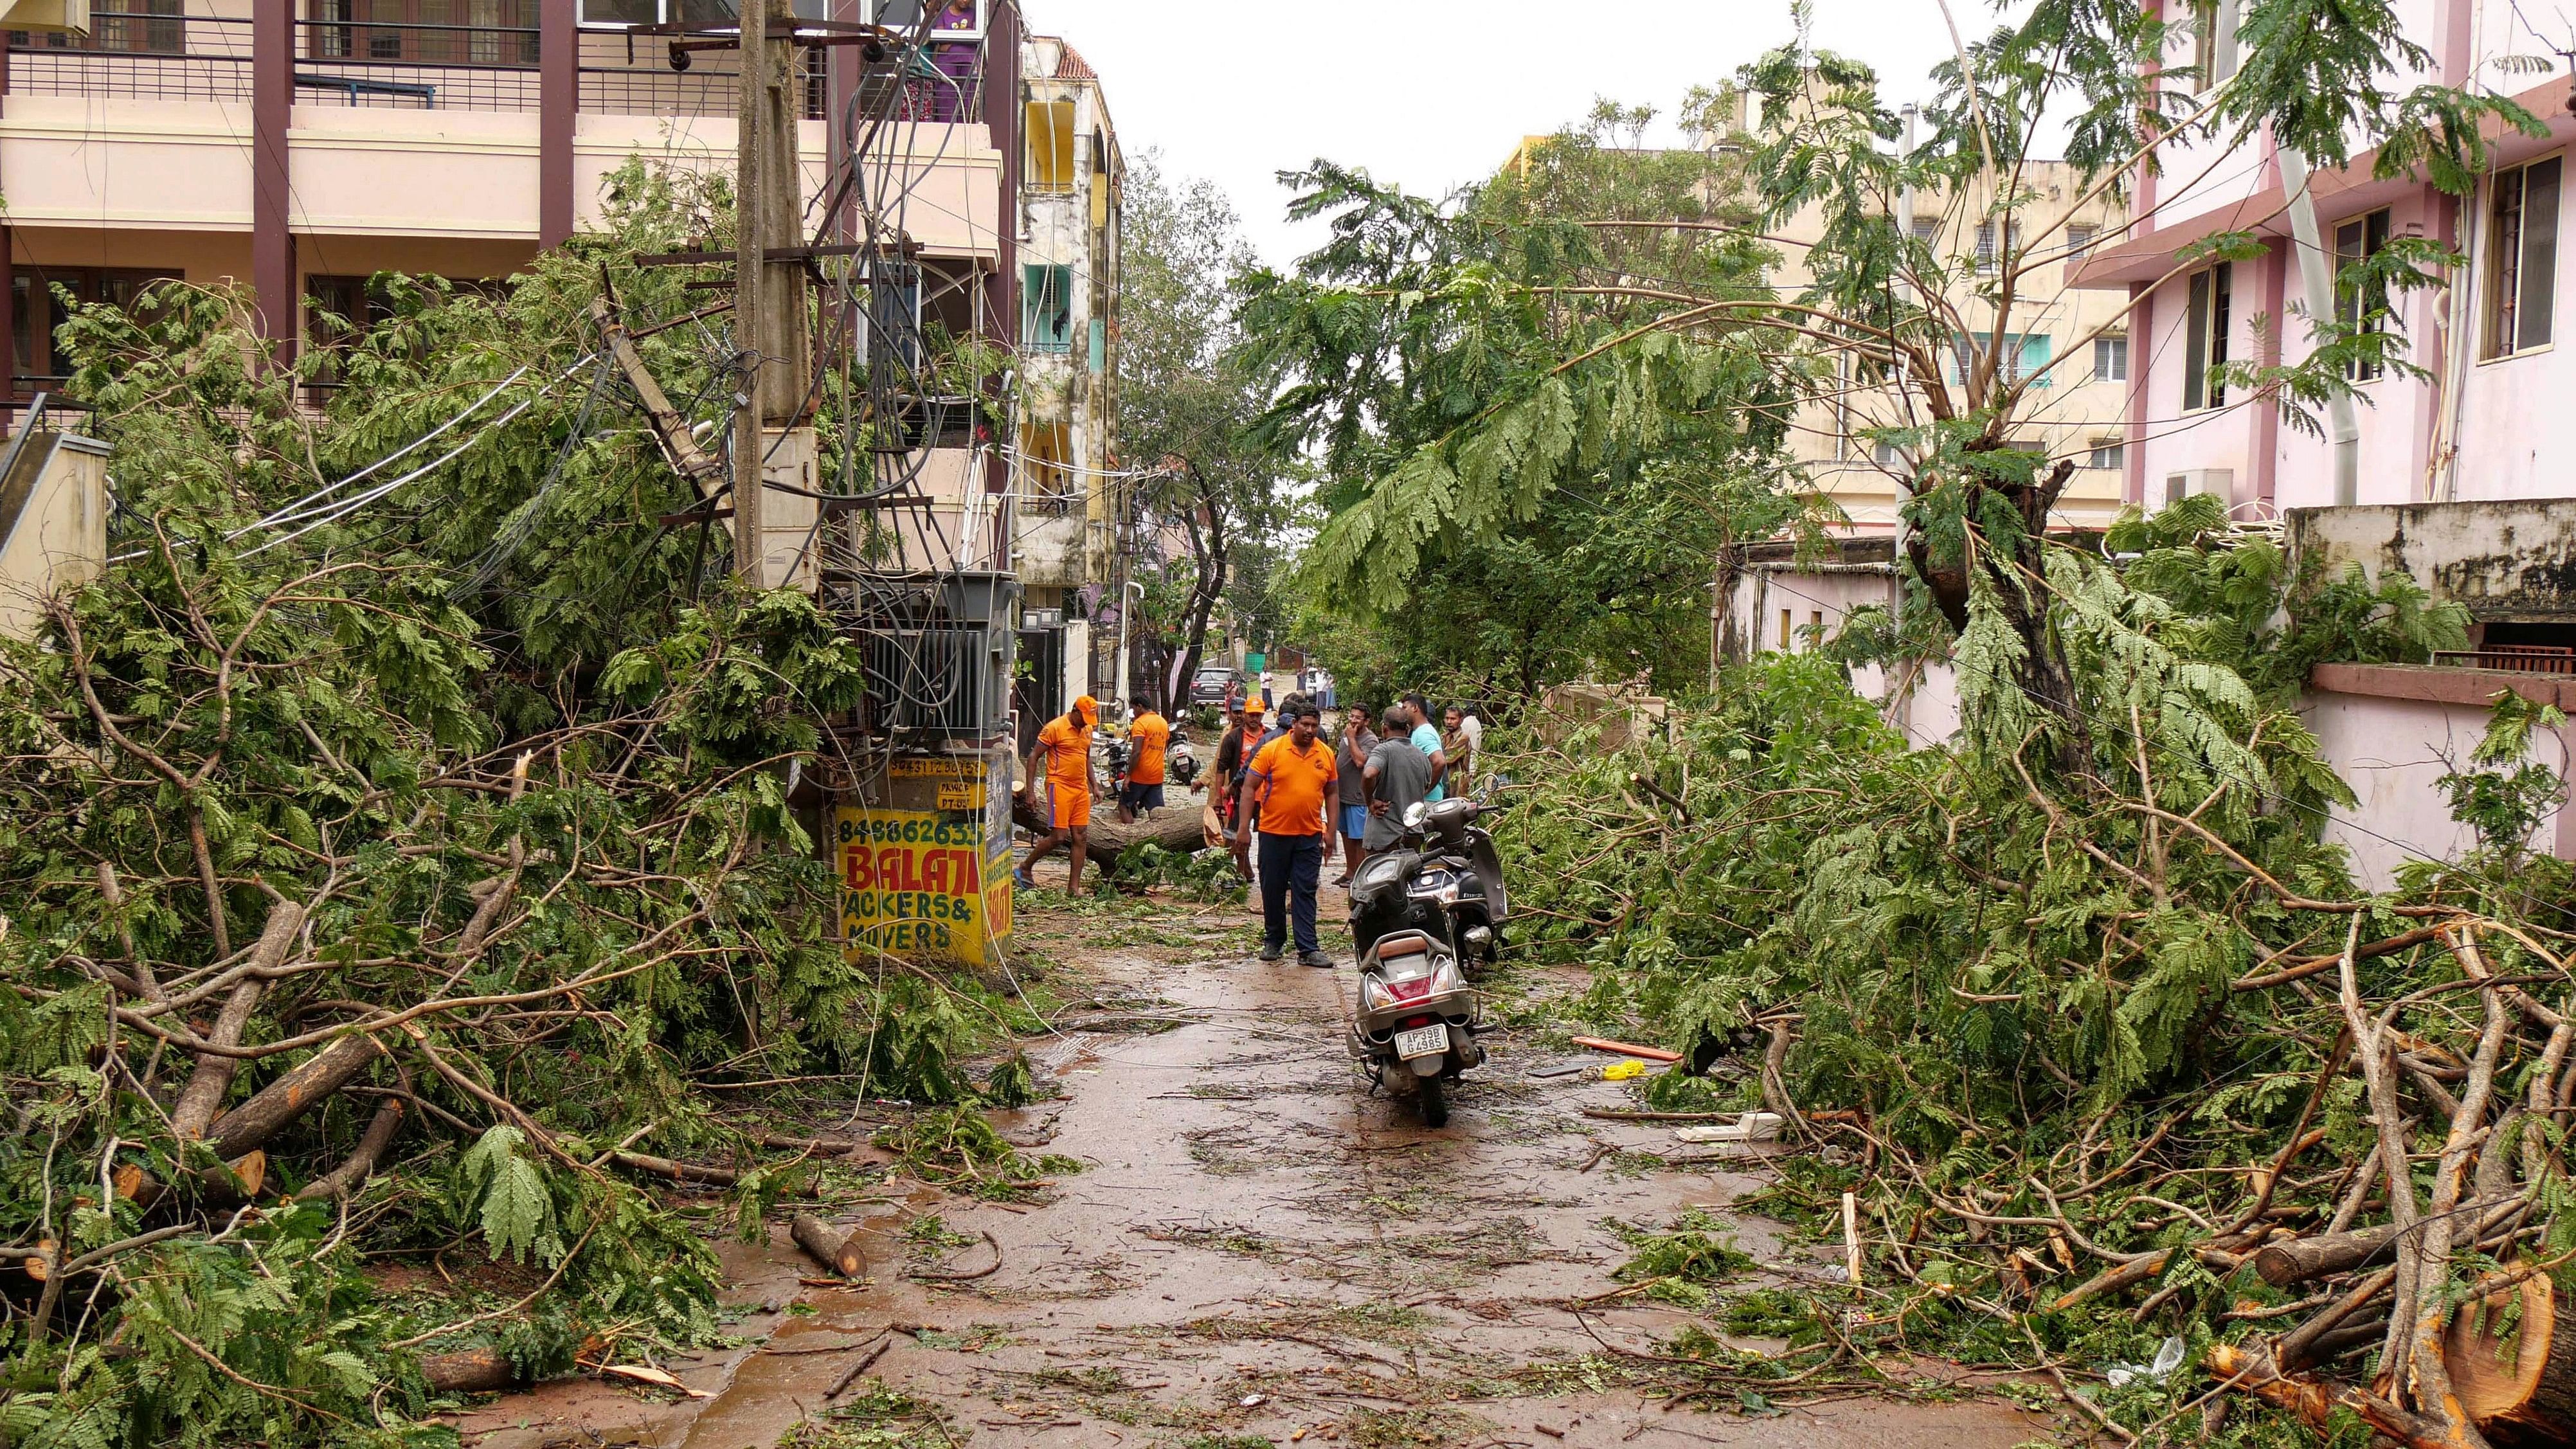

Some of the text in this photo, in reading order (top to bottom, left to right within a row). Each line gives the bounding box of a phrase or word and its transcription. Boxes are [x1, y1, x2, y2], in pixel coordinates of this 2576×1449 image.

[845, 847, 980, 897] BALAJI
[848, 922, 950, 950] MOVERS
[1407, 1029, 1439, 1043] AP 39B
[1416, 1038, 1441, 1050] 4985
